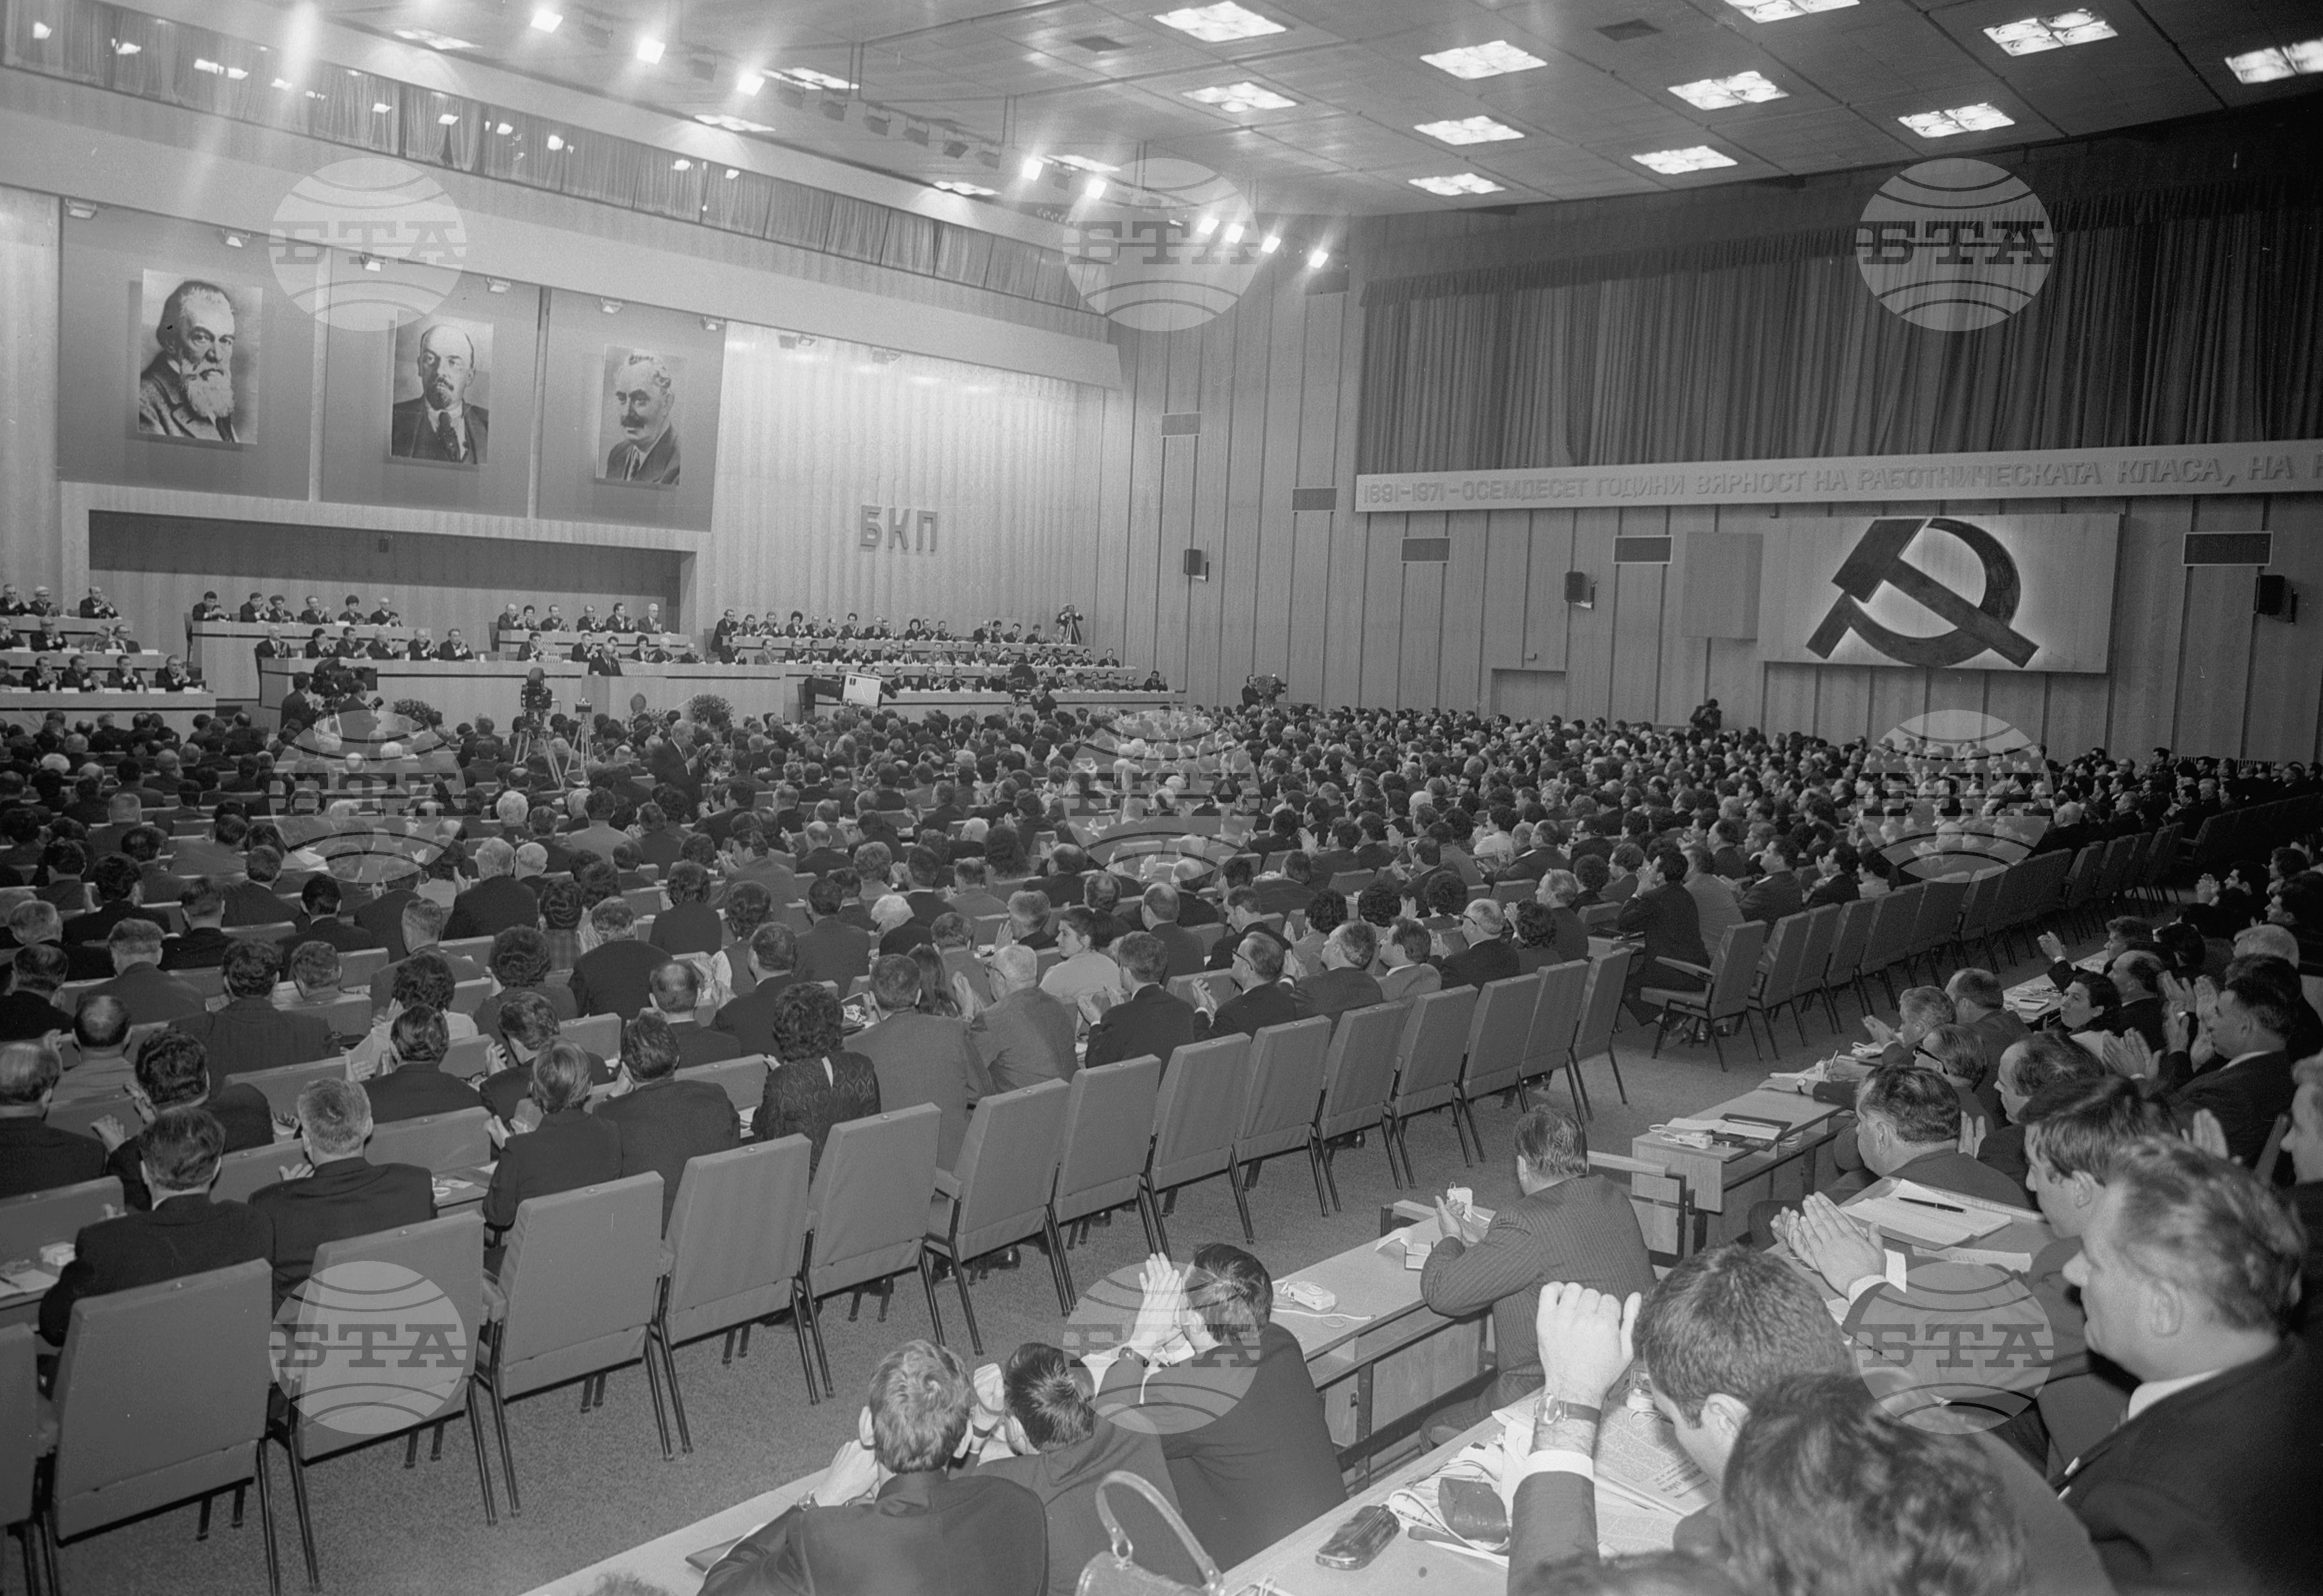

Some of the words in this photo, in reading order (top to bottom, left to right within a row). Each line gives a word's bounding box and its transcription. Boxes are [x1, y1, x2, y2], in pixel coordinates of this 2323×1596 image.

[1462, 477, 1588, 501] ОСЕМДЕСЕТ
[1596, 475, 1685, 498] ГОДИНИ
[1696, 470, 1807, 494] ВЯРНОСТ
[1814, 469, 1849, 492] НА
[1858, 462, 2103, 490] РАБОТНИЧЕСКАТА
[2117, 458, 2236, 487] КЛАСА,
[2248, 455, 2293, 481] НА
[860, 505, 938, 552] БКП
